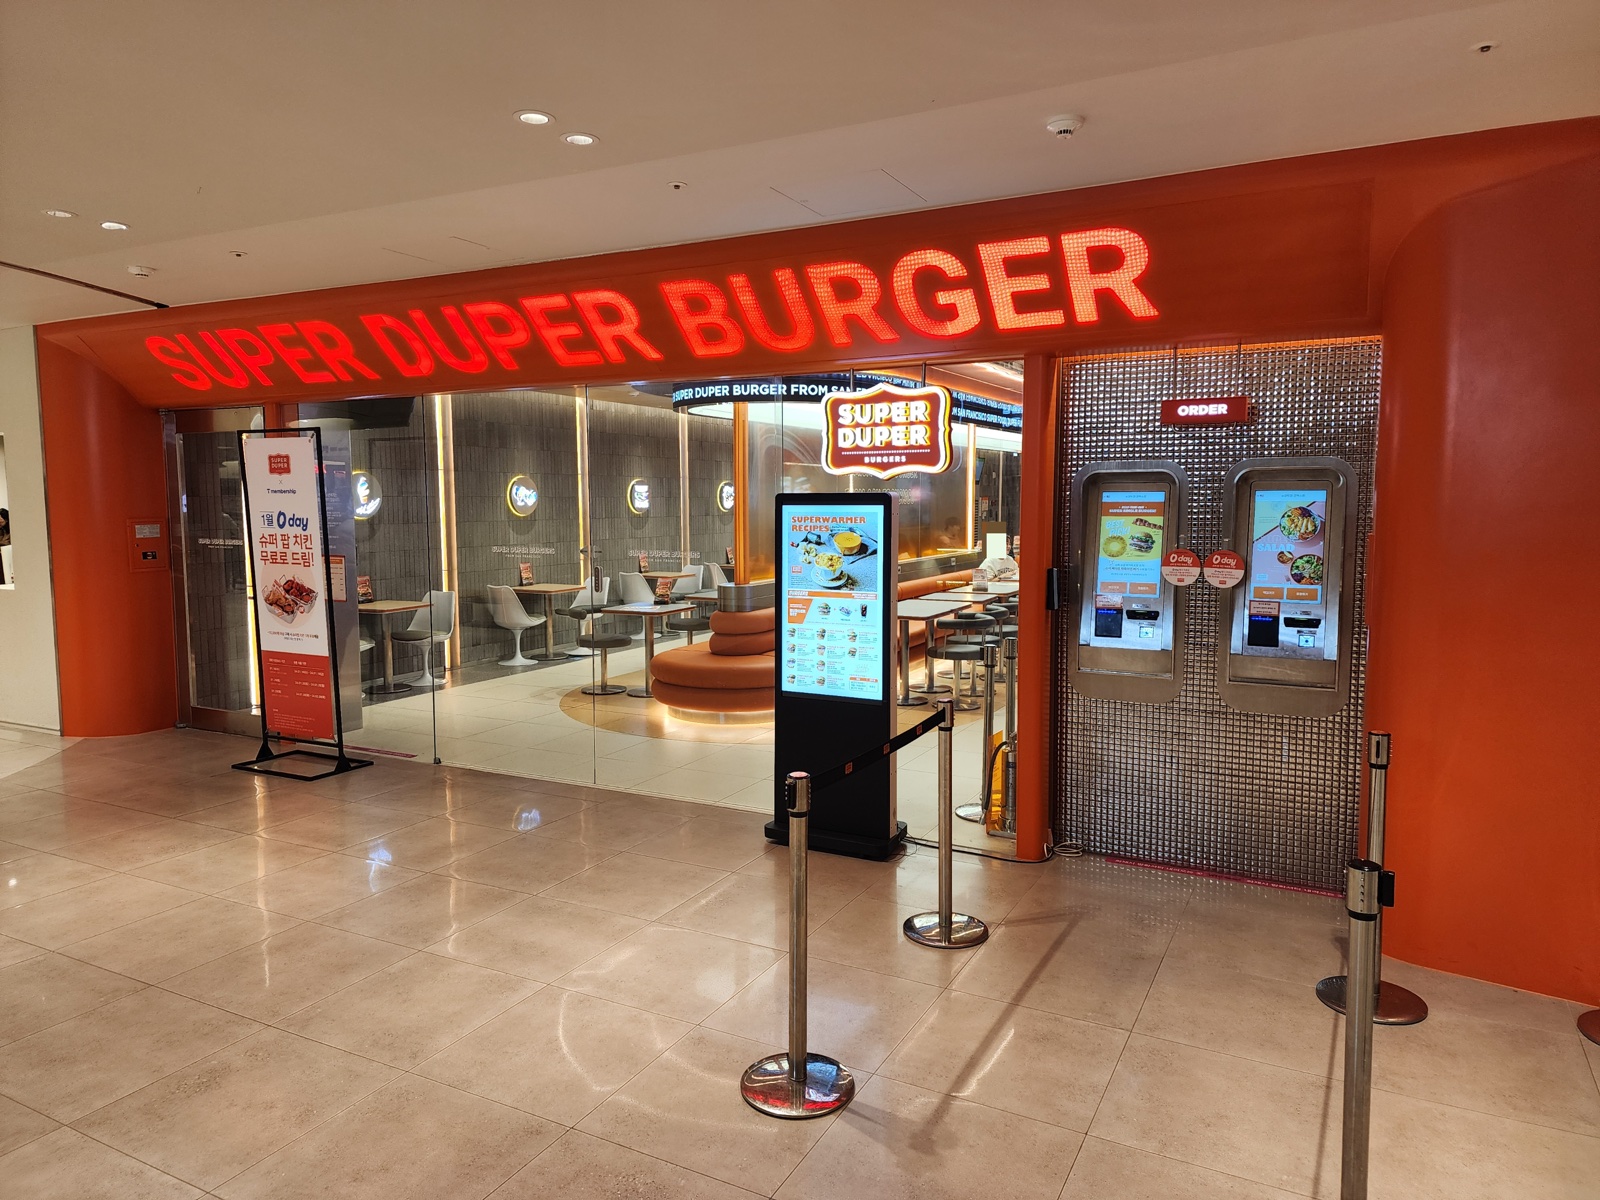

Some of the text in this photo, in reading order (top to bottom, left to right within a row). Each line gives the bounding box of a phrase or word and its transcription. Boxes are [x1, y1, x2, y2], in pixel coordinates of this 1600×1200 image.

[145, 227, 1160, 391] SUPER DUPER BURGER
[675, 388, 693, 400] SUPER
[695, 385, 729, 398] DUPER
[733, 384, 787, 396] BURGER
[791, 384, 828, 396] FROM
[837, 400, 930, 425] SUPER
[1177, 404, 1228, 416] ORDER
[837, 424, 930, 449] DUPER
[864, 455, 906, 463] BURGERS
[261, 513, 275, 527] 1월
[288, 513, 308, 531] day
[791, 516, 866, 524] SUPERWARMER
[791, 524, 830, 532] RECIPES
[259, 533, 313, 550] 슈퍼 팝 치킨
[1257, 543, 1295, 551] SALAD
[260, 550, 314, 567] 무료로 드림!
[1178, 554, 1193, 564] day
[1221, 556, 1237, 566] day
